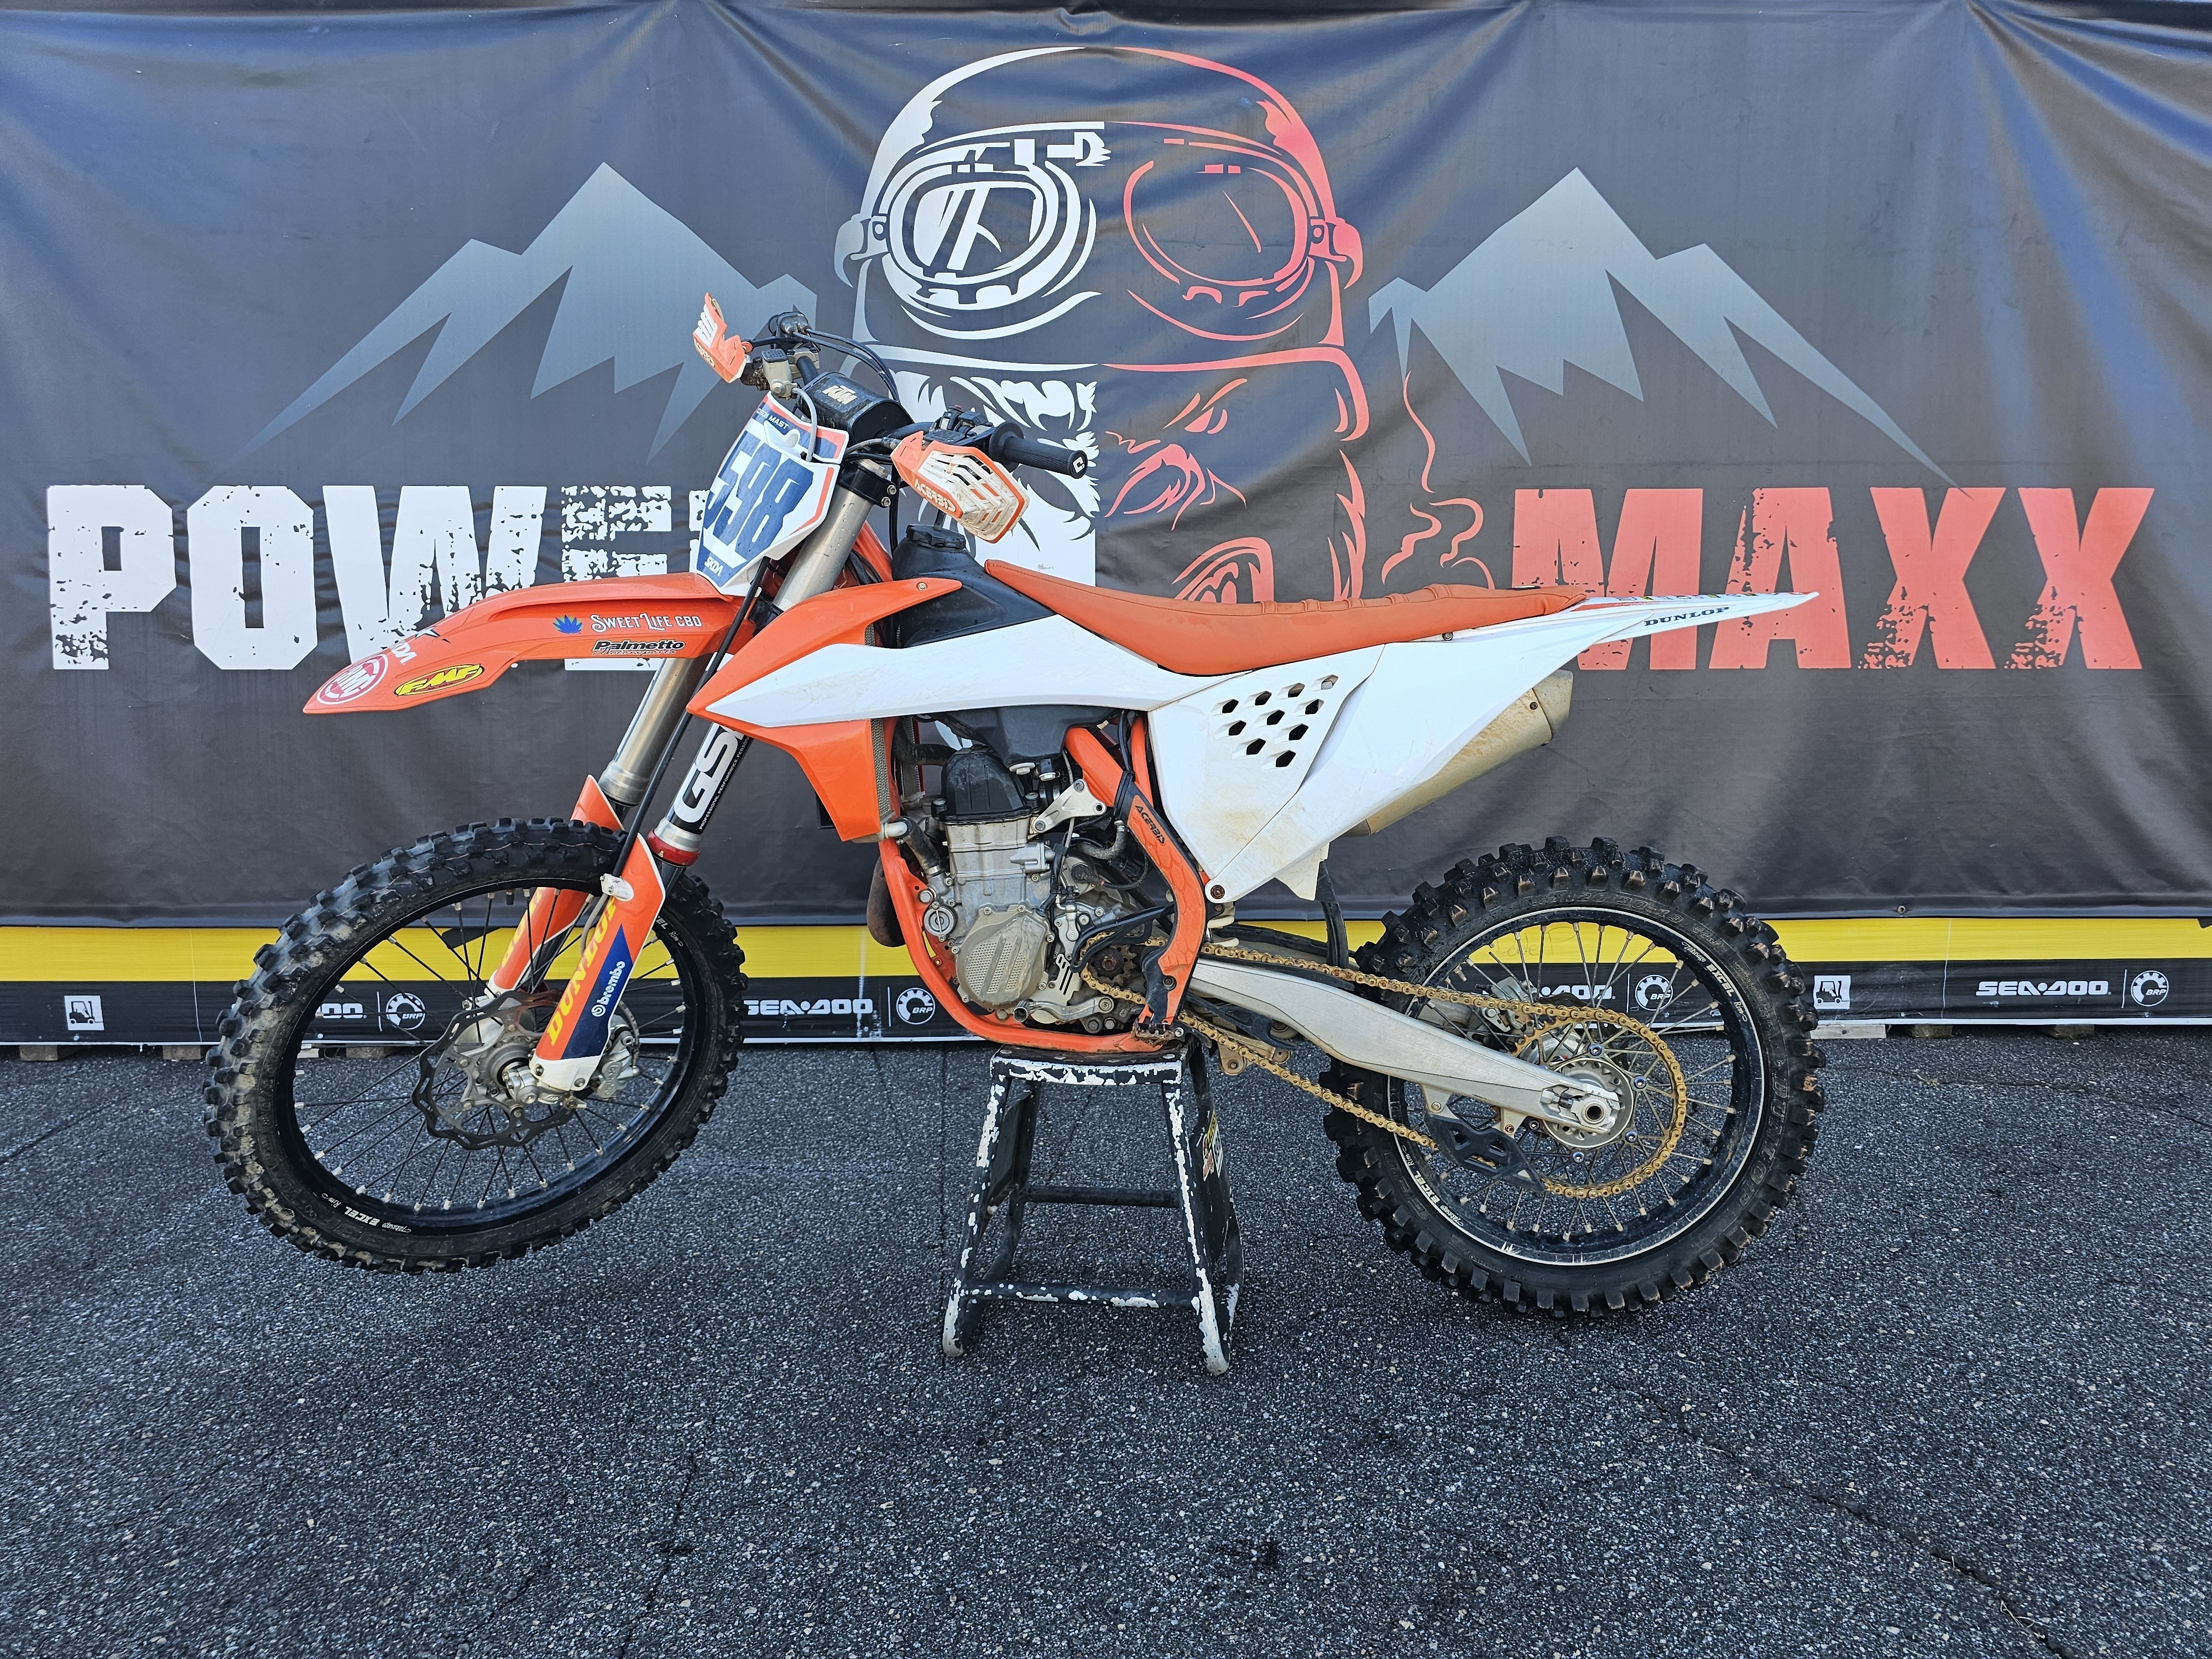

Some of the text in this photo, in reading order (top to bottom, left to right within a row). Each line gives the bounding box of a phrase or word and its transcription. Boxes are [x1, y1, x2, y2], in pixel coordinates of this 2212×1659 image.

[768, 415, 789, 429] MAST
[914, 478, 956, 512] ACERBIS
[46, 484, 713, 670] POWE
[1511, 487, 2155, 670] MAXX
[674, 615, 703, 628] CBD
[1644, 607, 1730, 627] DUNLOP
[592, 639, 686, 652] Palmetto
[397, 663, 481, 697] FMF
[1135, 805, 1165, 844] ACERBIS
[597, 961, 626, 1005] brembo
[1705, 963, 1735, 997] EXCEL
[1414, 1170, 1441, 1204] EXCEL
[343, 1206, 380, 1227] EXCEL
